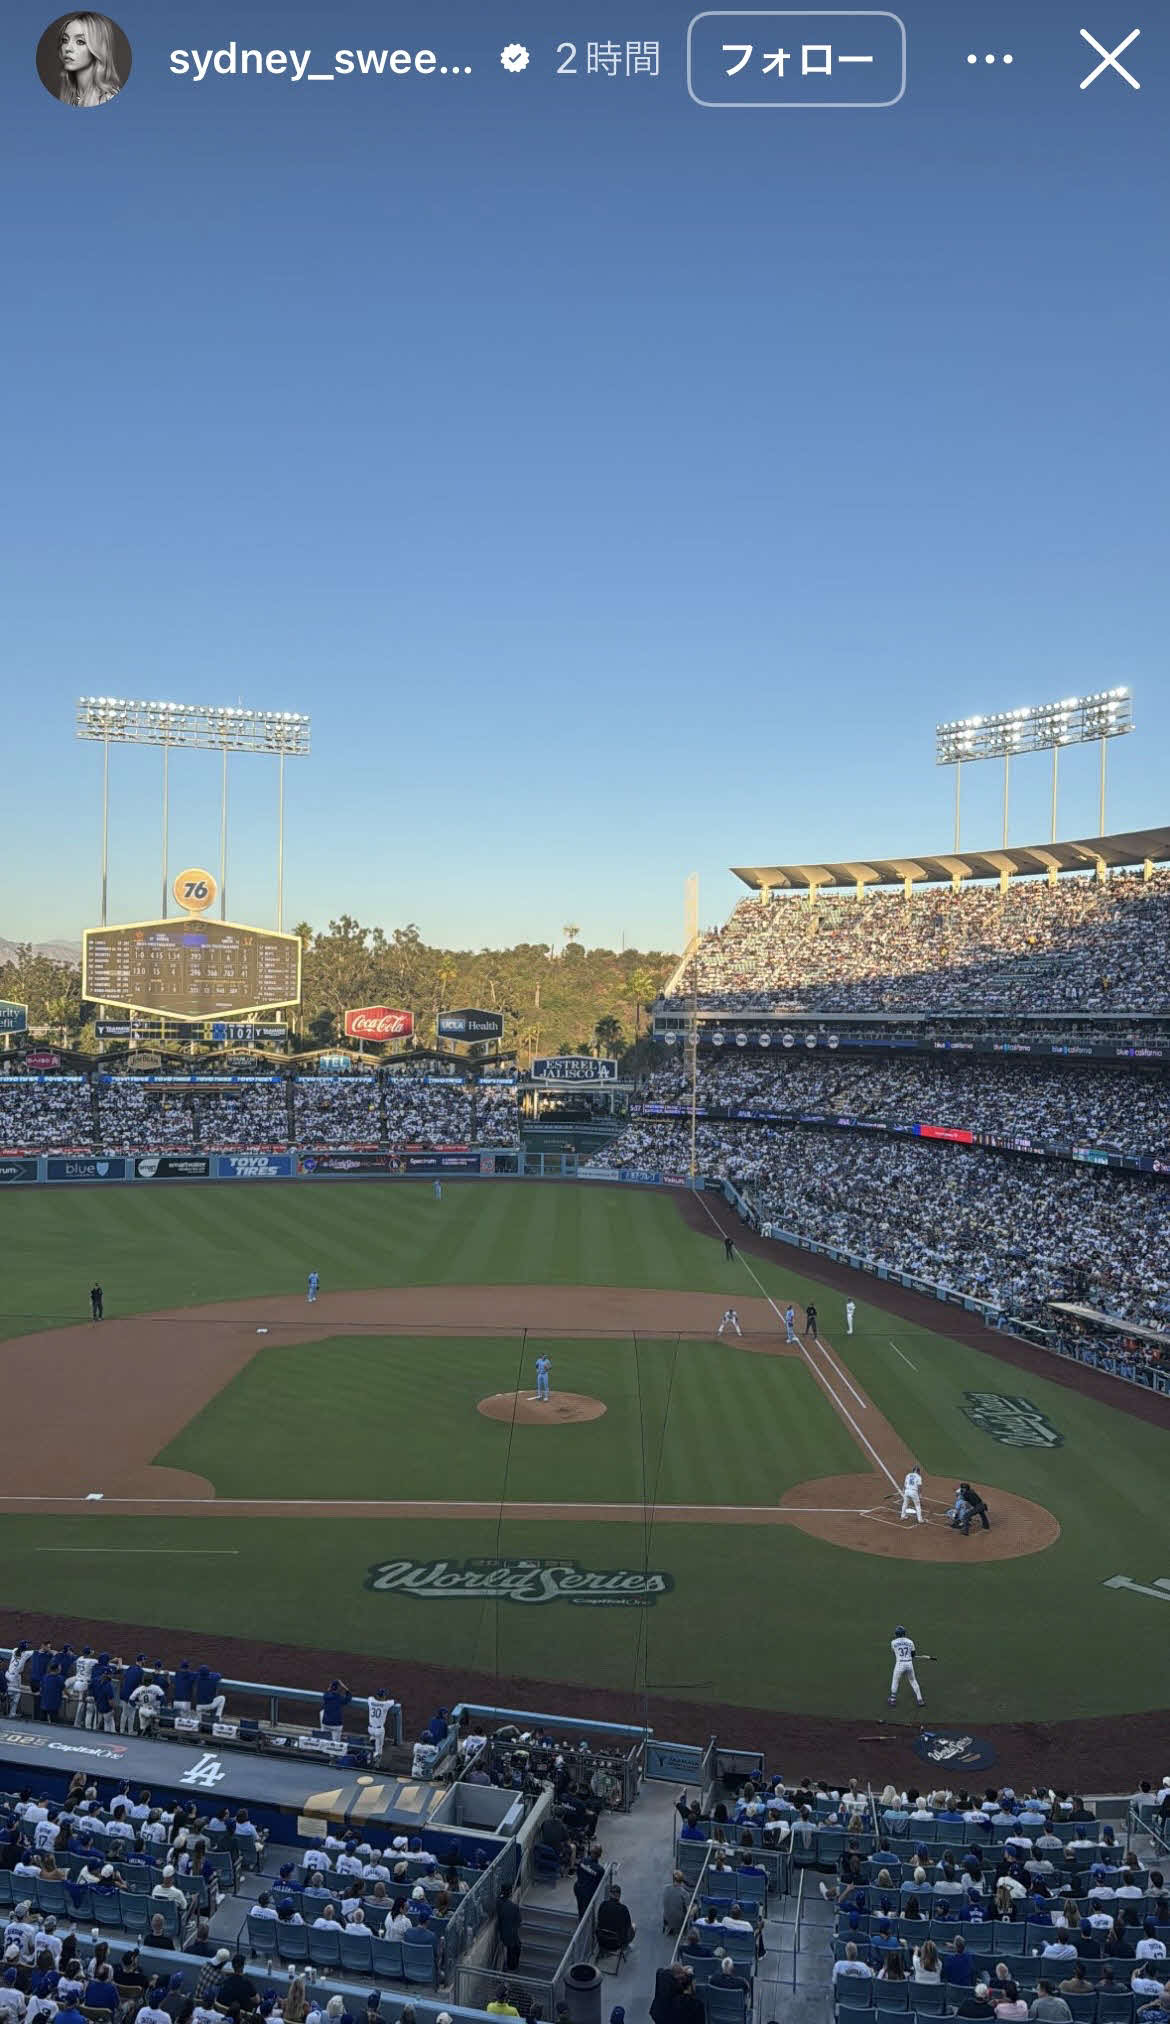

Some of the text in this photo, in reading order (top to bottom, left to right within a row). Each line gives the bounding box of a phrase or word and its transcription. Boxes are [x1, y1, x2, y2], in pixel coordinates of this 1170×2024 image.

[183, 881, 208, 899] 76
[468, 1021, 498, 1031] Health
[540, 1069, 595, 1079] JALISCO
[229, 1157, 269, 1167] TOYO
[65, 1162, 96, 1174] blue
[234, 1166, 279, 1176] TIRES
[373, 1561, 538, 1592] World
[897, 1647, 909, 1658] 37
[370, 1707, 382, 1719] 30
[180, 1753, 225, 1787] LA
